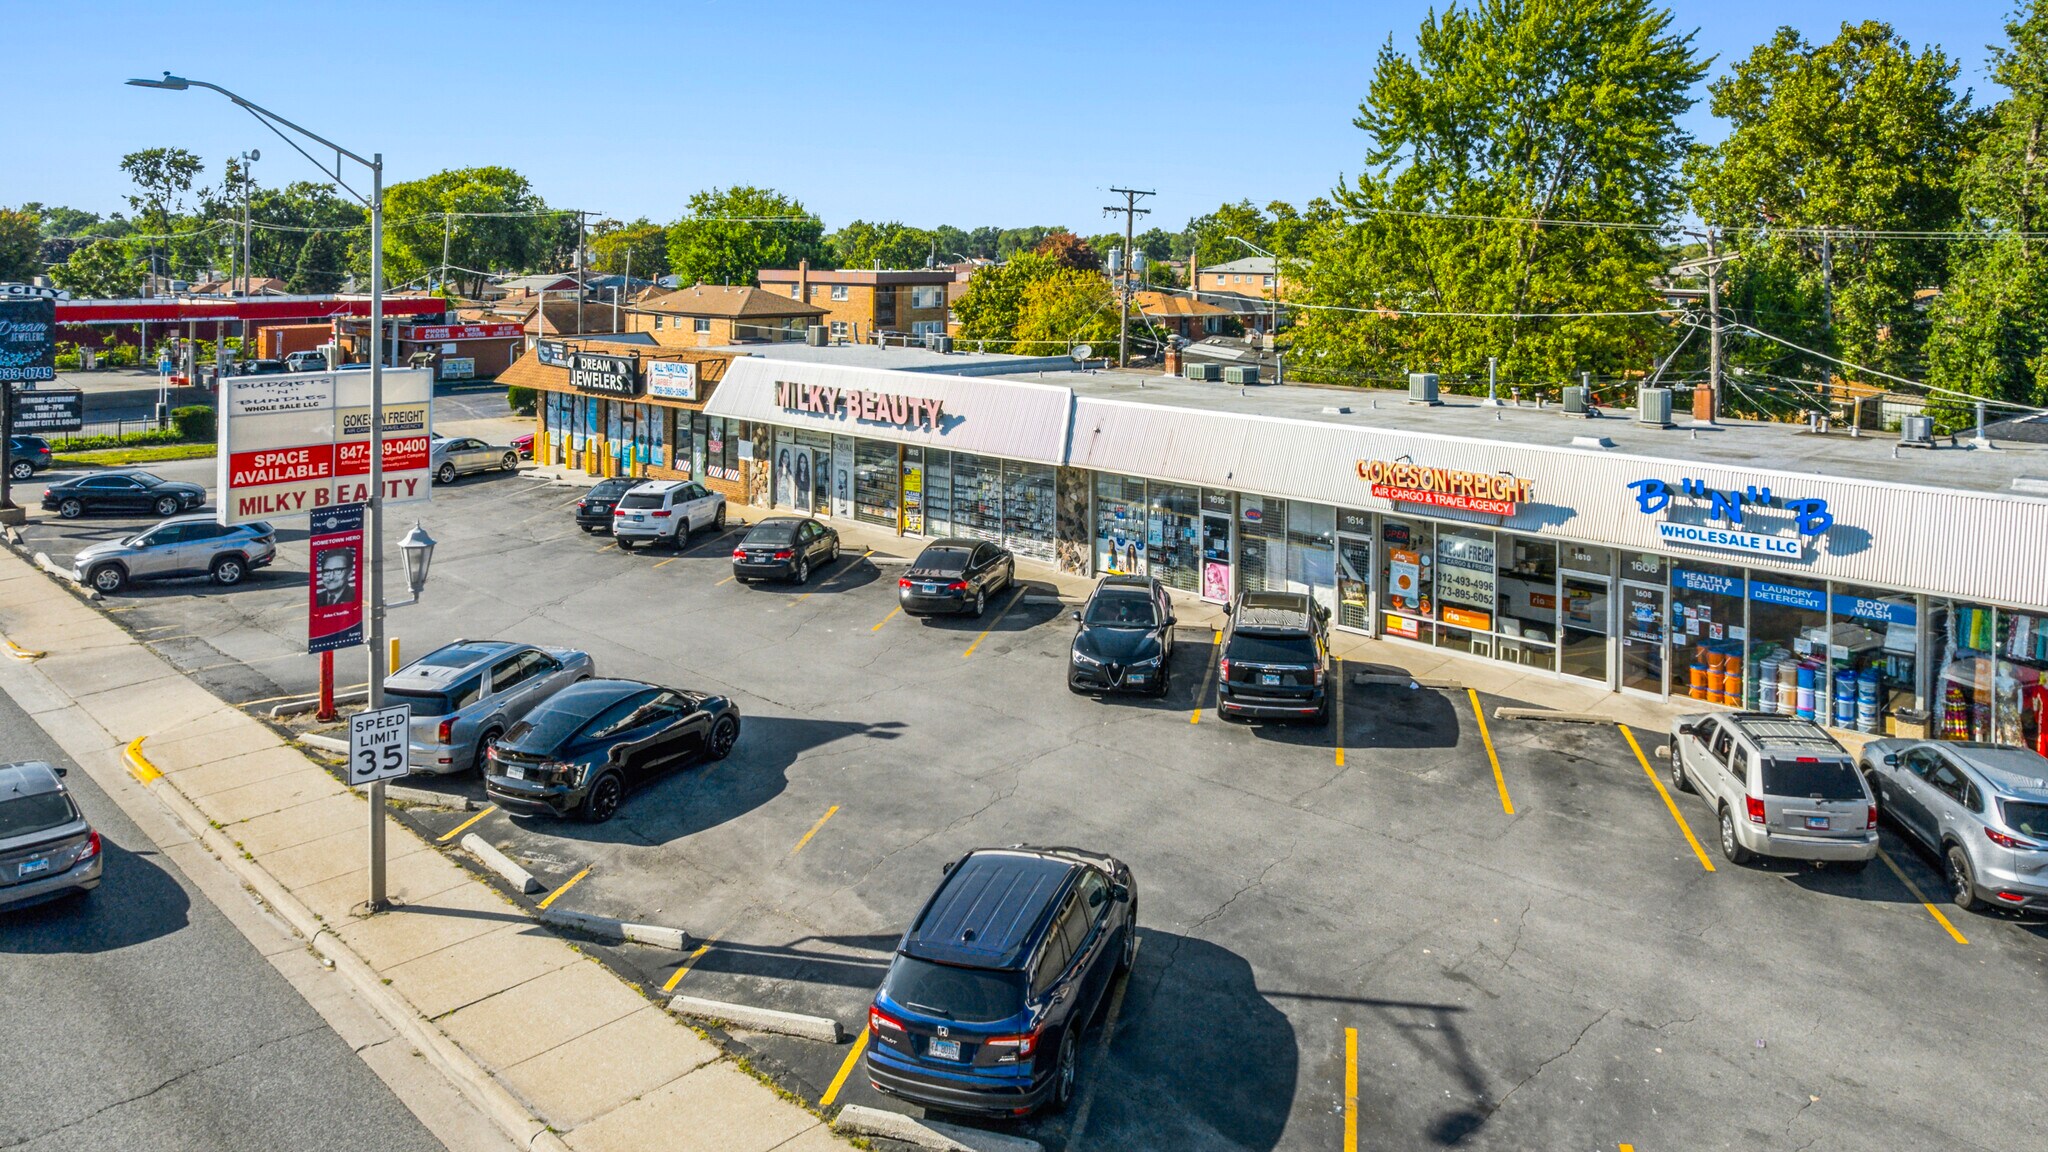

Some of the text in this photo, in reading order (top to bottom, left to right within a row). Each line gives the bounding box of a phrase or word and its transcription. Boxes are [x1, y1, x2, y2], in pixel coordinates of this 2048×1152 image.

[11, 332, 45, 342] JEWELERS
[581, 357, 611, 372] DREAM
[654, 363, 688, 375] ALL-NATIONS
[570, 370, 623, 391] JEWELERS
[21, 396, 76, 404] MONDAY-SATURDAY
[235, 394, 327, 405] BUNDLES
[775, 380, 944, 430] MILKY BEAUTY
[244, 403, 278, 412] WHOLE
[14, 420, 39, 428] CALUMET
[343, 410, 424, 427] GOKESN FREIGHT
[340, 438, 427, 459] 847-9-0400
[254, 450, 309, 468] SPACE
[406, 452, 426, 460] Company
[233, 462, 328, 485] AVAILABLE
[1355, 459, 1533, 505] GOKESON FREIGHT
[239, 478, 419, 516] MILKY BEATY
[1209, 494, 1226, 505] 1616
[1373, 486, 1511, 514] AIR CARGO & TRAVEL AGENCY
[1627, 478, 1670, 514] B
[1785, 498, 1834, 536] B
[1245, 510, 1261, 518] OPEN
[1345, 515, 1364, 526] 1614
[312, 534, 361, 546] HOMETOWN HERO
[1385, 530, 1409, 540] OPEN
[1660, 524, 1797, 554] WHOLESALE LLC
[1447, 558, 1467, 568] CARGO
[1574, 553, 1592, 561] 1610
[1630, 561, 1658, 574] 1608
[1437, 572, 1494, 592] 312-493-4996
[1682, 572, 1733, 587] HEALTH &
[1686, 580, 1728, 593] BEAUTY
[1761, 584, 1813, 599] LAUNDRY
[1436, 585, 1494, 605] 773-895-6052
[1532, 595, 1545, 605] ria
[1635, 589, 1652, 598] 1608
[1755, 590, 1820, 607] DETERGENT
[1856, 599, 1891, 611] BODY
[1446, 610, 1460, 621] ria
[1855, 607, 1892, 620] WASH
[355, 713, 405, 733] SPEED
[360, 729, 400, 747] LIMIT
[356, 744, 403, 776] 35
